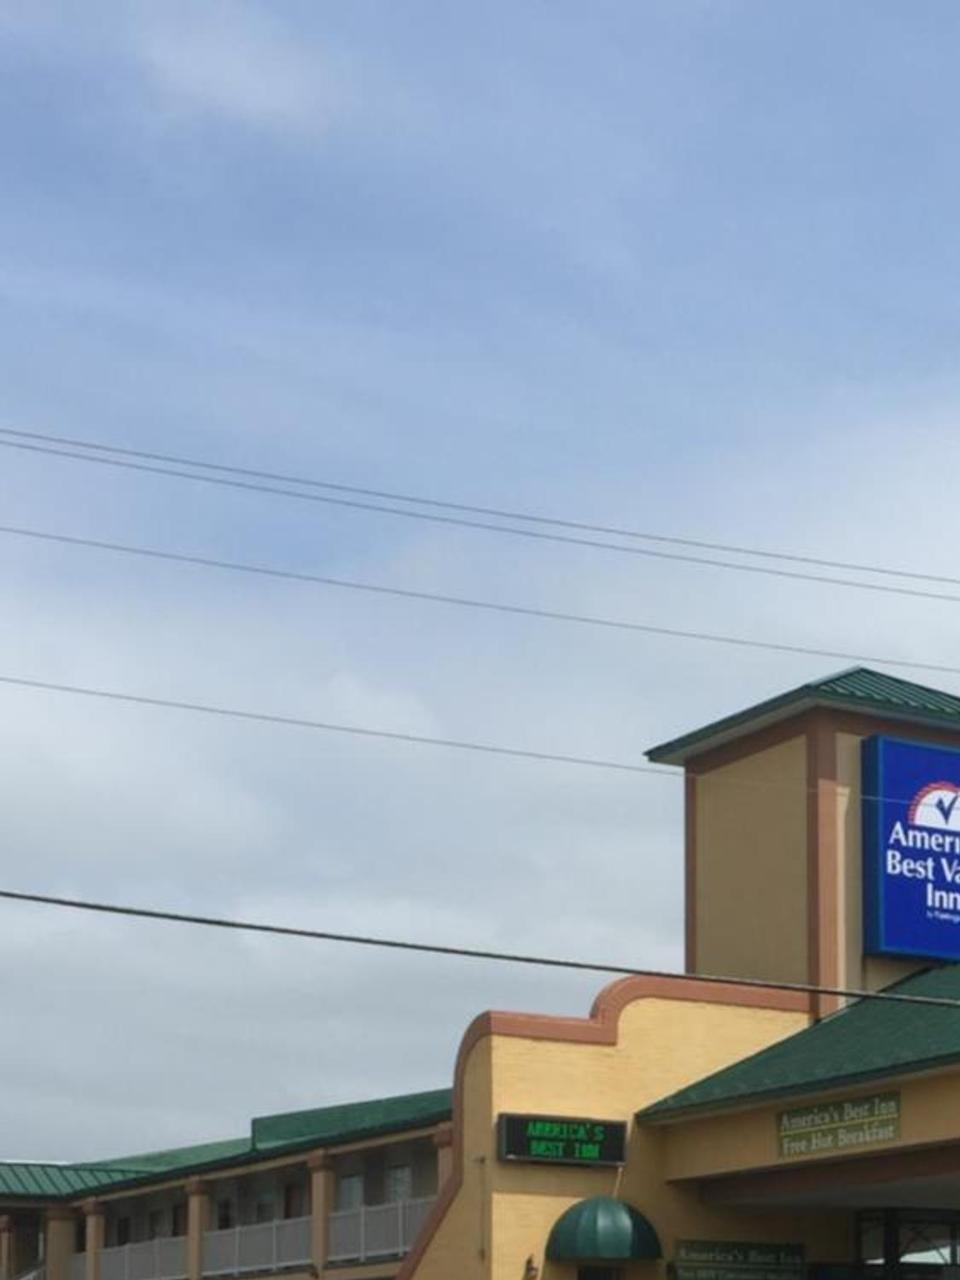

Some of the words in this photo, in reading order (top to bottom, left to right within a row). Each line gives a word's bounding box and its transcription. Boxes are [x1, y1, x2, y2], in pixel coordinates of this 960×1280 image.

[886, 848, 935, 881] Best
[526, 1119, 605, 1142] AMERICA'S
[781, 1106, 841, 1131] America's
[843, 1101, 871, 1121] Best
[873, 1097, 898, 1116] Inn
[530, 1139, 564, 1158] BEST
[574, 1141, 600, 1158] INN
[783, 1136, 808, 1157] Free
[810, 1131, 834, 1152] Hot
[837, 1121, 895, 1147] Breakfast
